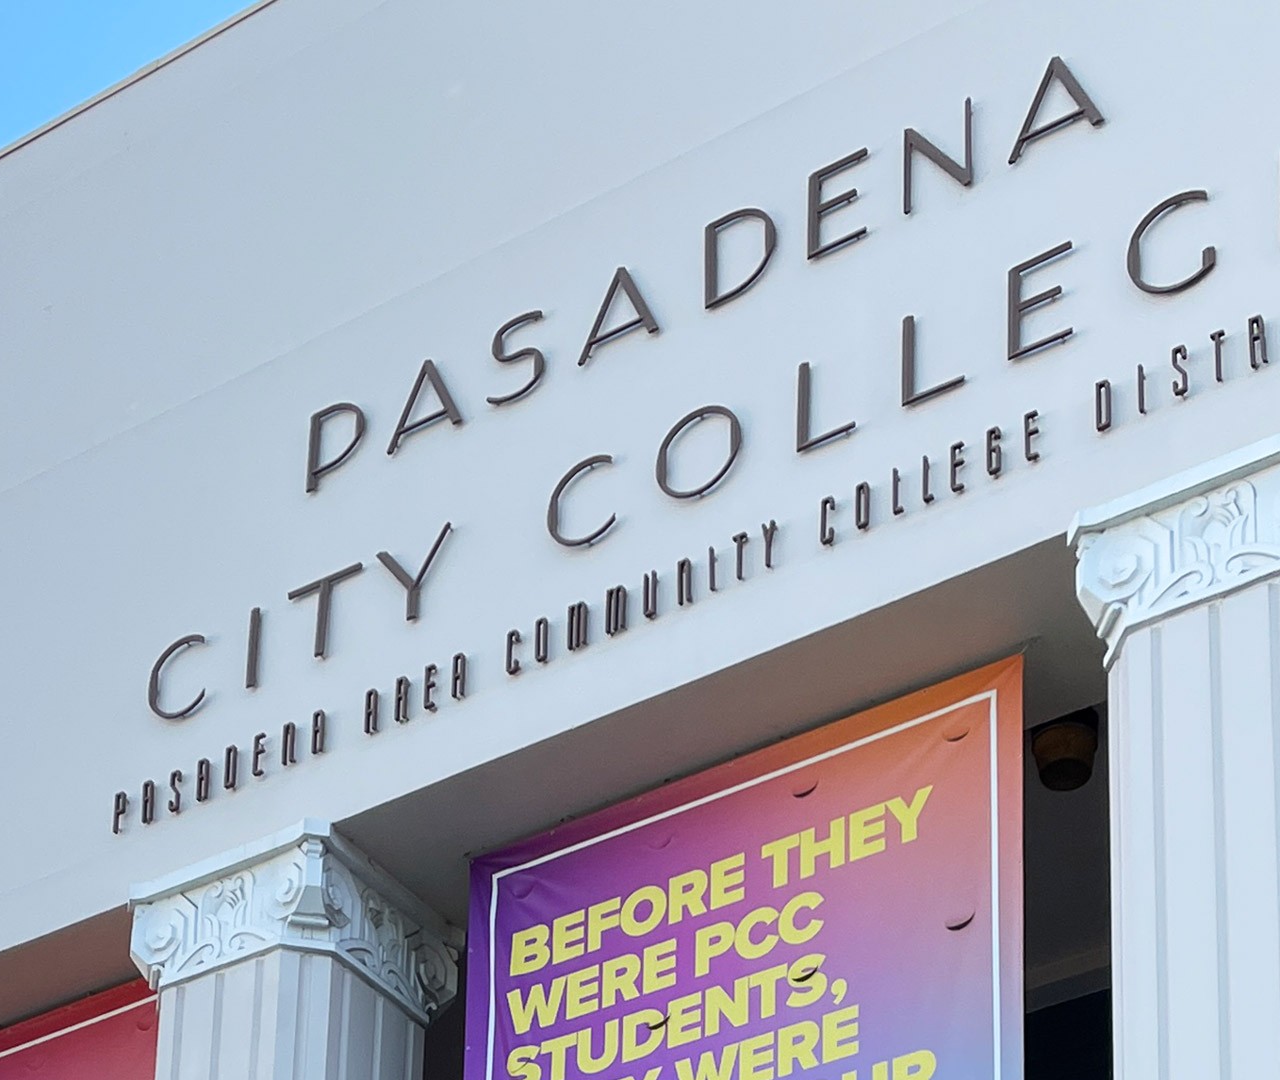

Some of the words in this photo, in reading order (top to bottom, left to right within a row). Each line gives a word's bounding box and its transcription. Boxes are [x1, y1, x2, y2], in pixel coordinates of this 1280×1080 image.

[306, 55, 1104, 494] PASADENA
[113, 709, 325, 834] PASADENA
[364, 652, 466, 734] AREA
[506, 519, 777, 675] COMMUNITY
[820, 409, 1040, 546] COLLEGE
[148, 522, 454, 720] CITY
[506, 938, 677, 1035] WERE
[694, 892, 824, 978] PCC
[508, 852, 745, 977] BEFORE
[760, 785, 933, 888] THEY
